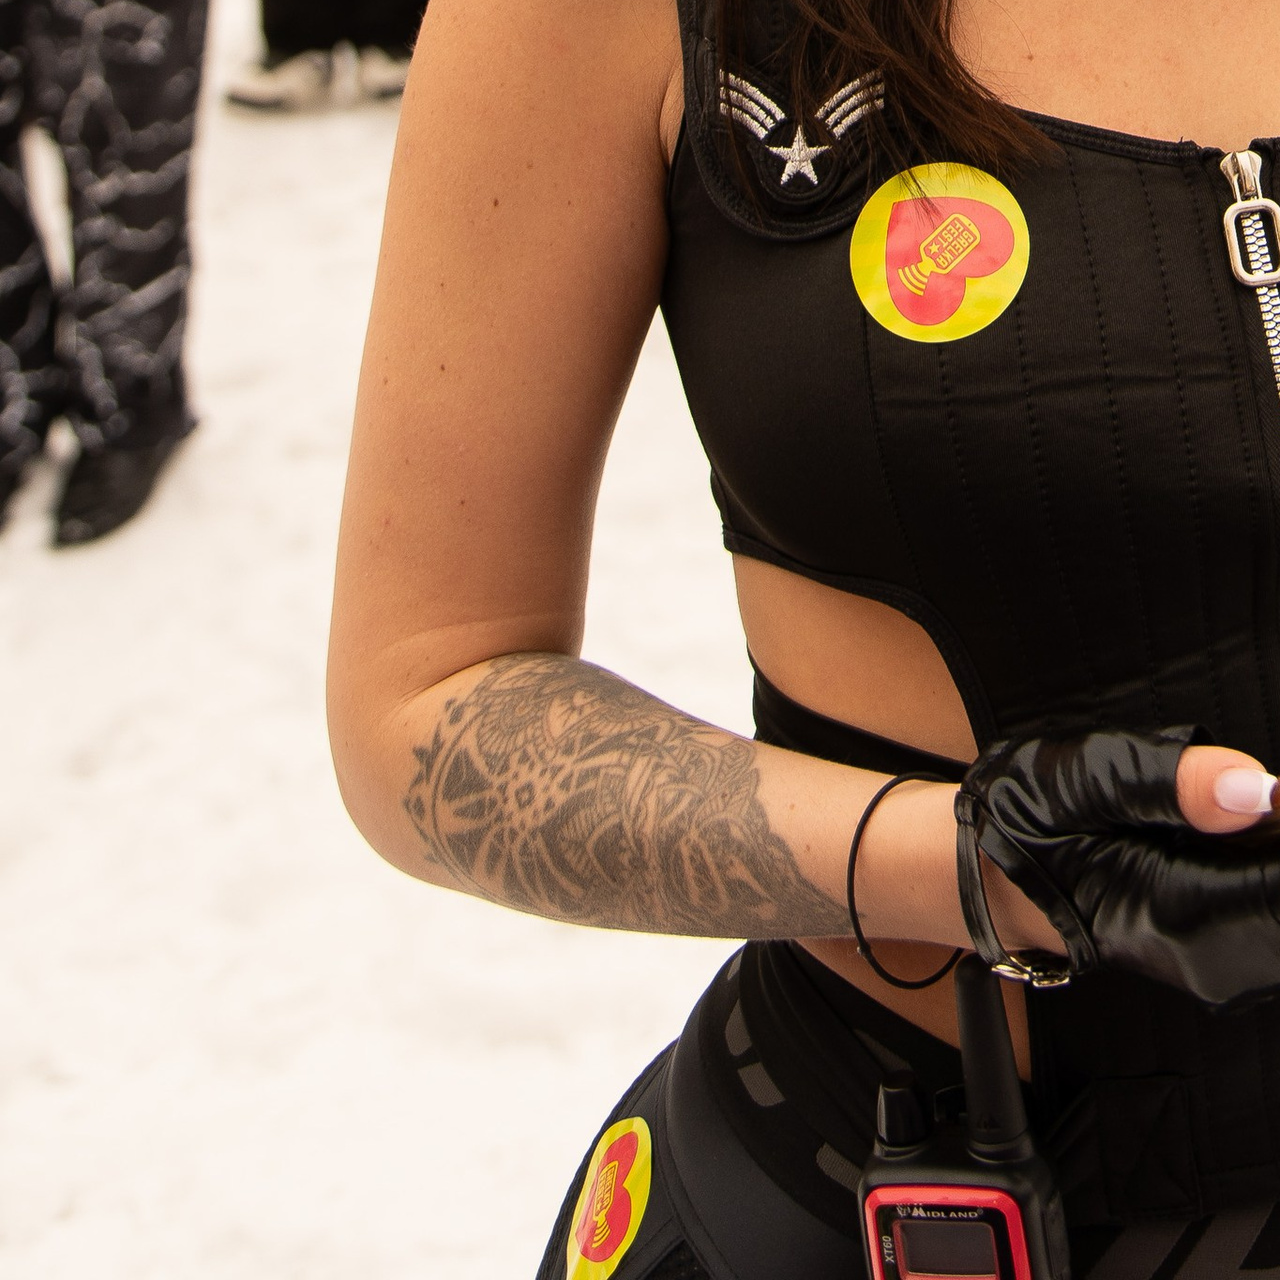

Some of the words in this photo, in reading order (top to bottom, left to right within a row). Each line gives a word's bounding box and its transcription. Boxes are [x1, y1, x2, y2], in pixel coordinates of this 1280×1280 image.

[939, 220, 964, 248] FEST
[911, 1206, 978, 1218] MIDLAND
[882, 1235, 895, 1263] XT60
